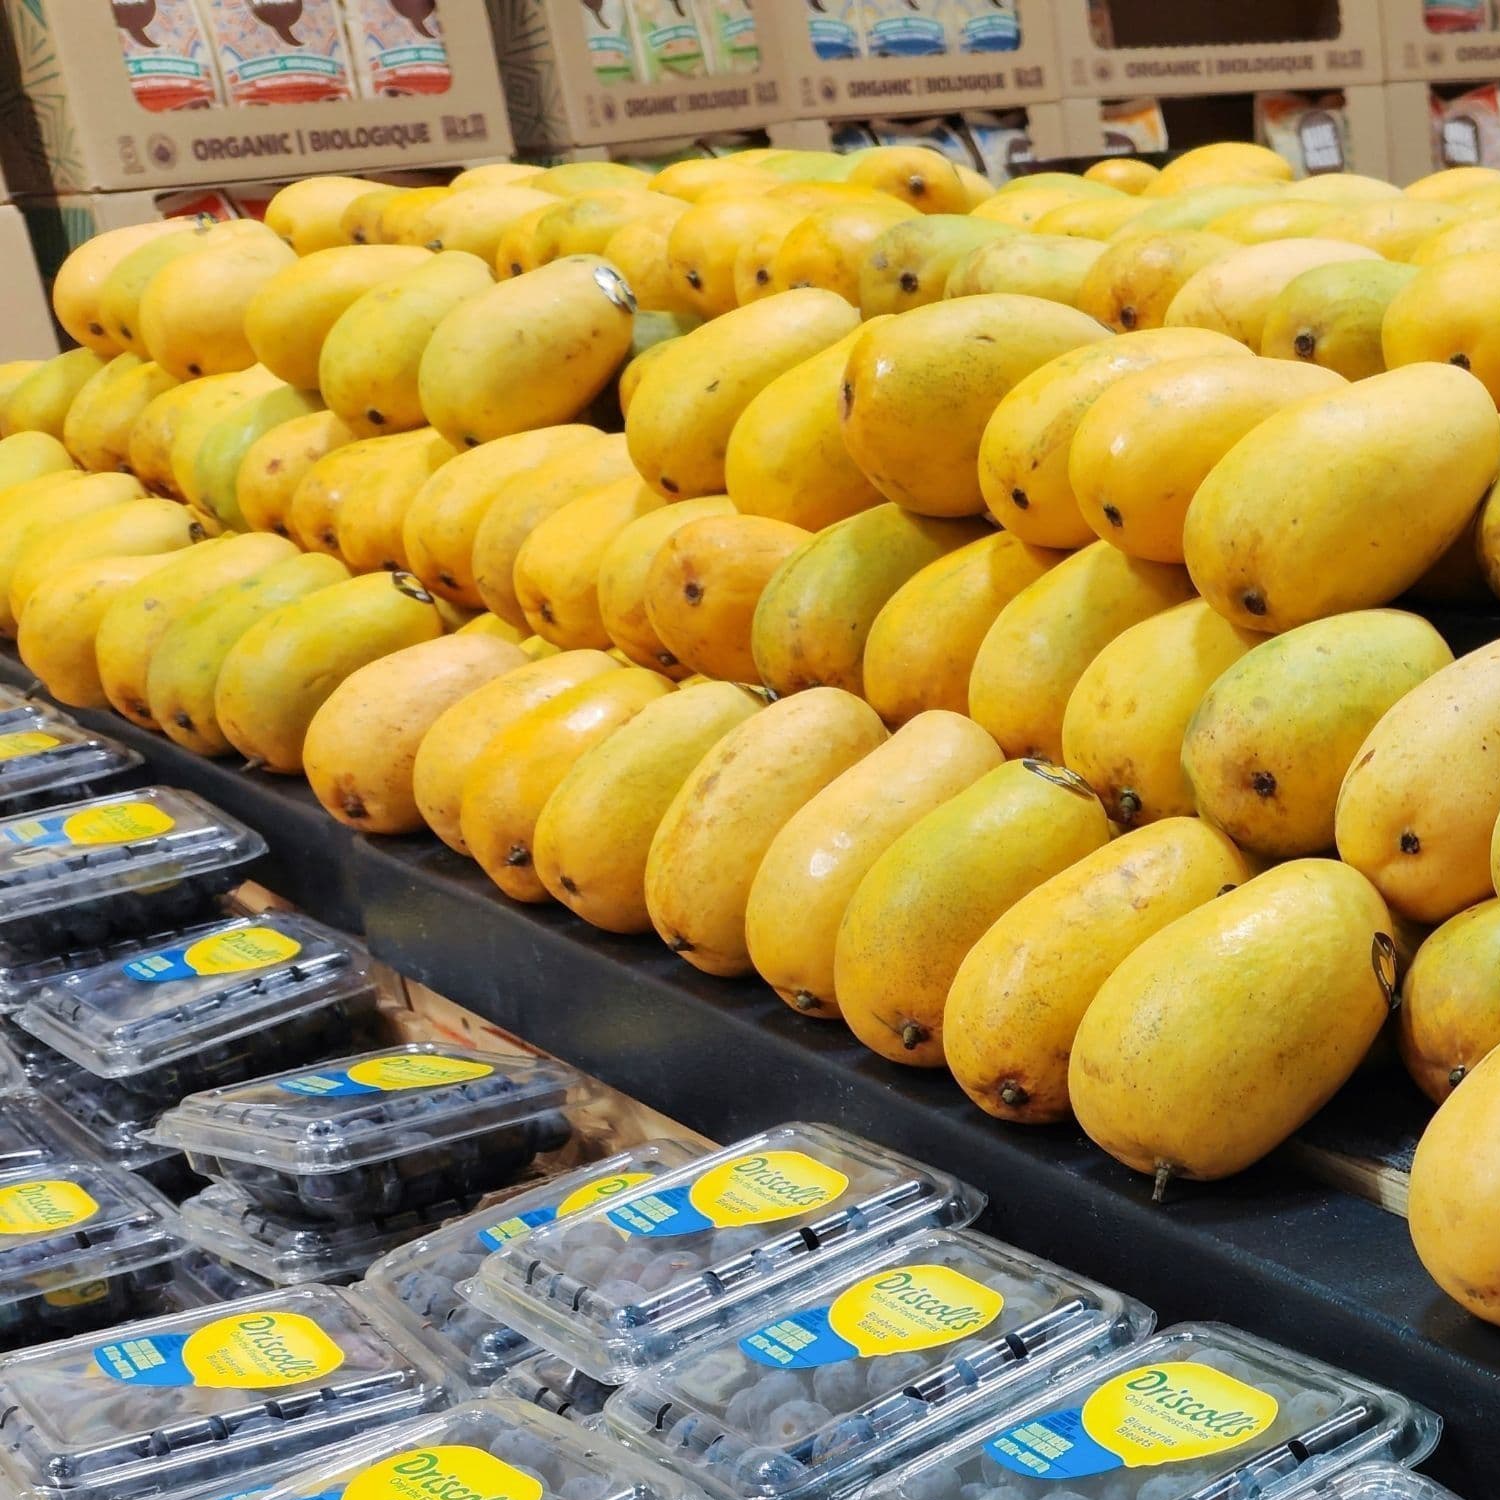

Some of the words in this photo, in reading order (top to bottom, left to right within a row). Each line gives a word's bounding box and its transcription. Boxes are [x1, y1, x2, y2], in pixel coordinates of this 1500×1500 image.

[192, 132, 291, 162] ORGANIC
[310, 122, 431, 154] BIOLOGIQUE
[734, 1157, 830, 1206] Driscoll's
[875, 1272, 986, 1330] Driscoll's
[857, 1320, 888, 1340] Bleuets
[865, 1311, 909, 1338] Blueberries
[239, 1316, 320, 1378] Driscoll's
[1125, 1393, 1145, 1409] Only
[1143, 1403, 1158, 1415] the
[1158, 1410, 1184, 1427] Finest
[1182, 1422, 1210, 1440] Berries
[1126, 1370, 1260, 1438] Driscoll's
[1115, 1426, 1153, 1448] Bleuets
[1124, 1416, 1178, 1447] Blueberries
